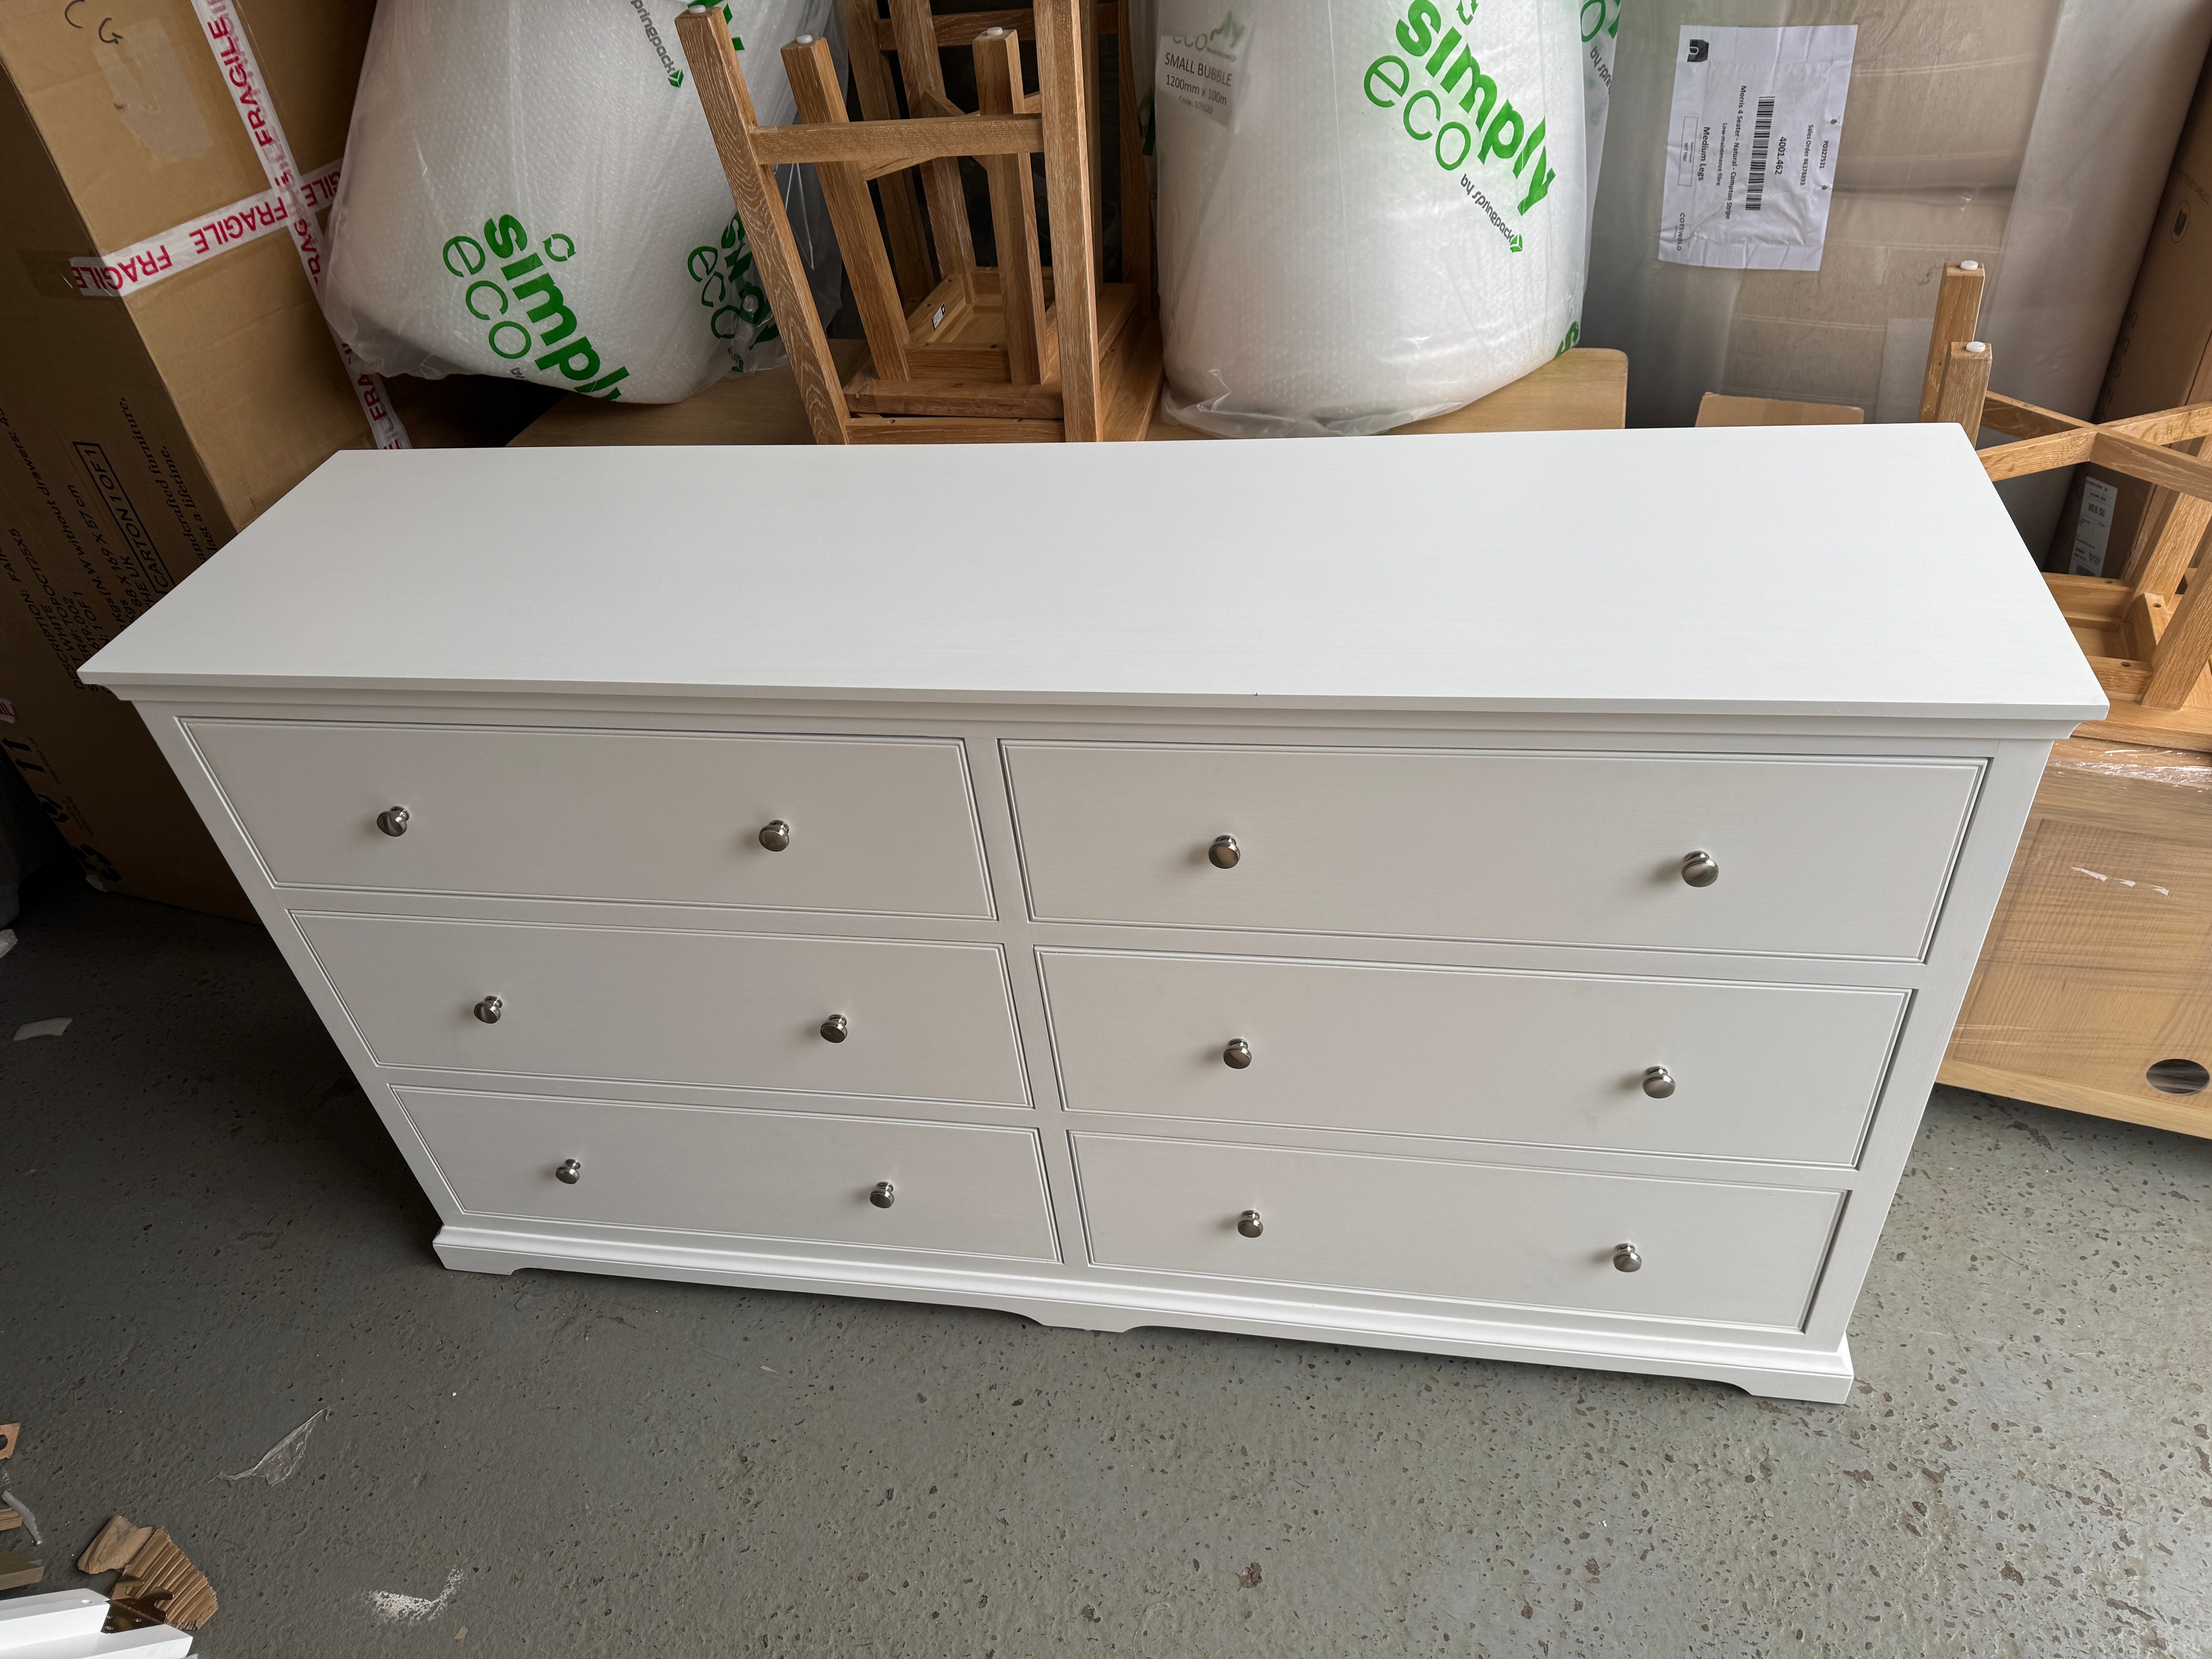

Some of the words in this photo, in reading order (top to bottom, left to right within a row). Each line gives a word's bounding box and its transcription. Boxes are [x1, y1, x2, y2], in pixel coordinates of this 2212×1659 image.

[630, 0, 675, 73] pringpack
[1590, 46, 1602, 67] by
[207, 16, 273, 147] FRAGILE
[1165, 53, 1194, 74] SMALL
[1198, 63, 1232, 86] BUBBLE
[1166, 75, 1199, 95] 1200mm
[1209, 88, 1227, 105] 100m
[1364, 55, 1471, 170] eco
[1396, 0, 1556, 216] simply
[1700, 127, 1710, 161] Medium
[1718, 123, 1728, 172] Low-maintenance
[1775, 136, 1786, 174] 4001.462
[1698, 164, 1706, 181] Legs
[1727, 172, 1736, 201] Compton
[189, 197, 288, 254] FRAGILE
[1461, 173, 1475, 195] by
[1472, 191, 1515, 243] springpack
[1677, 213, 1685, 251] COTSWOLD
[71, 245, 172, 290] FRAGILE
[443, 235, 532, 359] eco
[484, 214, 630, 402] simpl
[119, 397, 162, 475] furniture,
[8, 431, 50, 496] drawers:
[90, 460, 114, 490] OF
[161, 446, 196, 508] lifetime.
[68, 485, 85, 507] cm
[79, 510, 98, 529] 57
[193, 513, 203, 522] a
[47, 500, 84, 555] without
[155, 479, 206, 563] andcrafted
[101, 547, 122, 571] 169
[115, 508, 168, 588] CARTON
[119, 556, 139, 577] UK
[9, 528, 72, 626] TOPOCT25X5
[125, 589, 142, 607] 88
[41, 604, 76, 652] WHITE
[78, 600, 96, 621] OF
[21, 589, 85, 690] DESCRIPTION:
